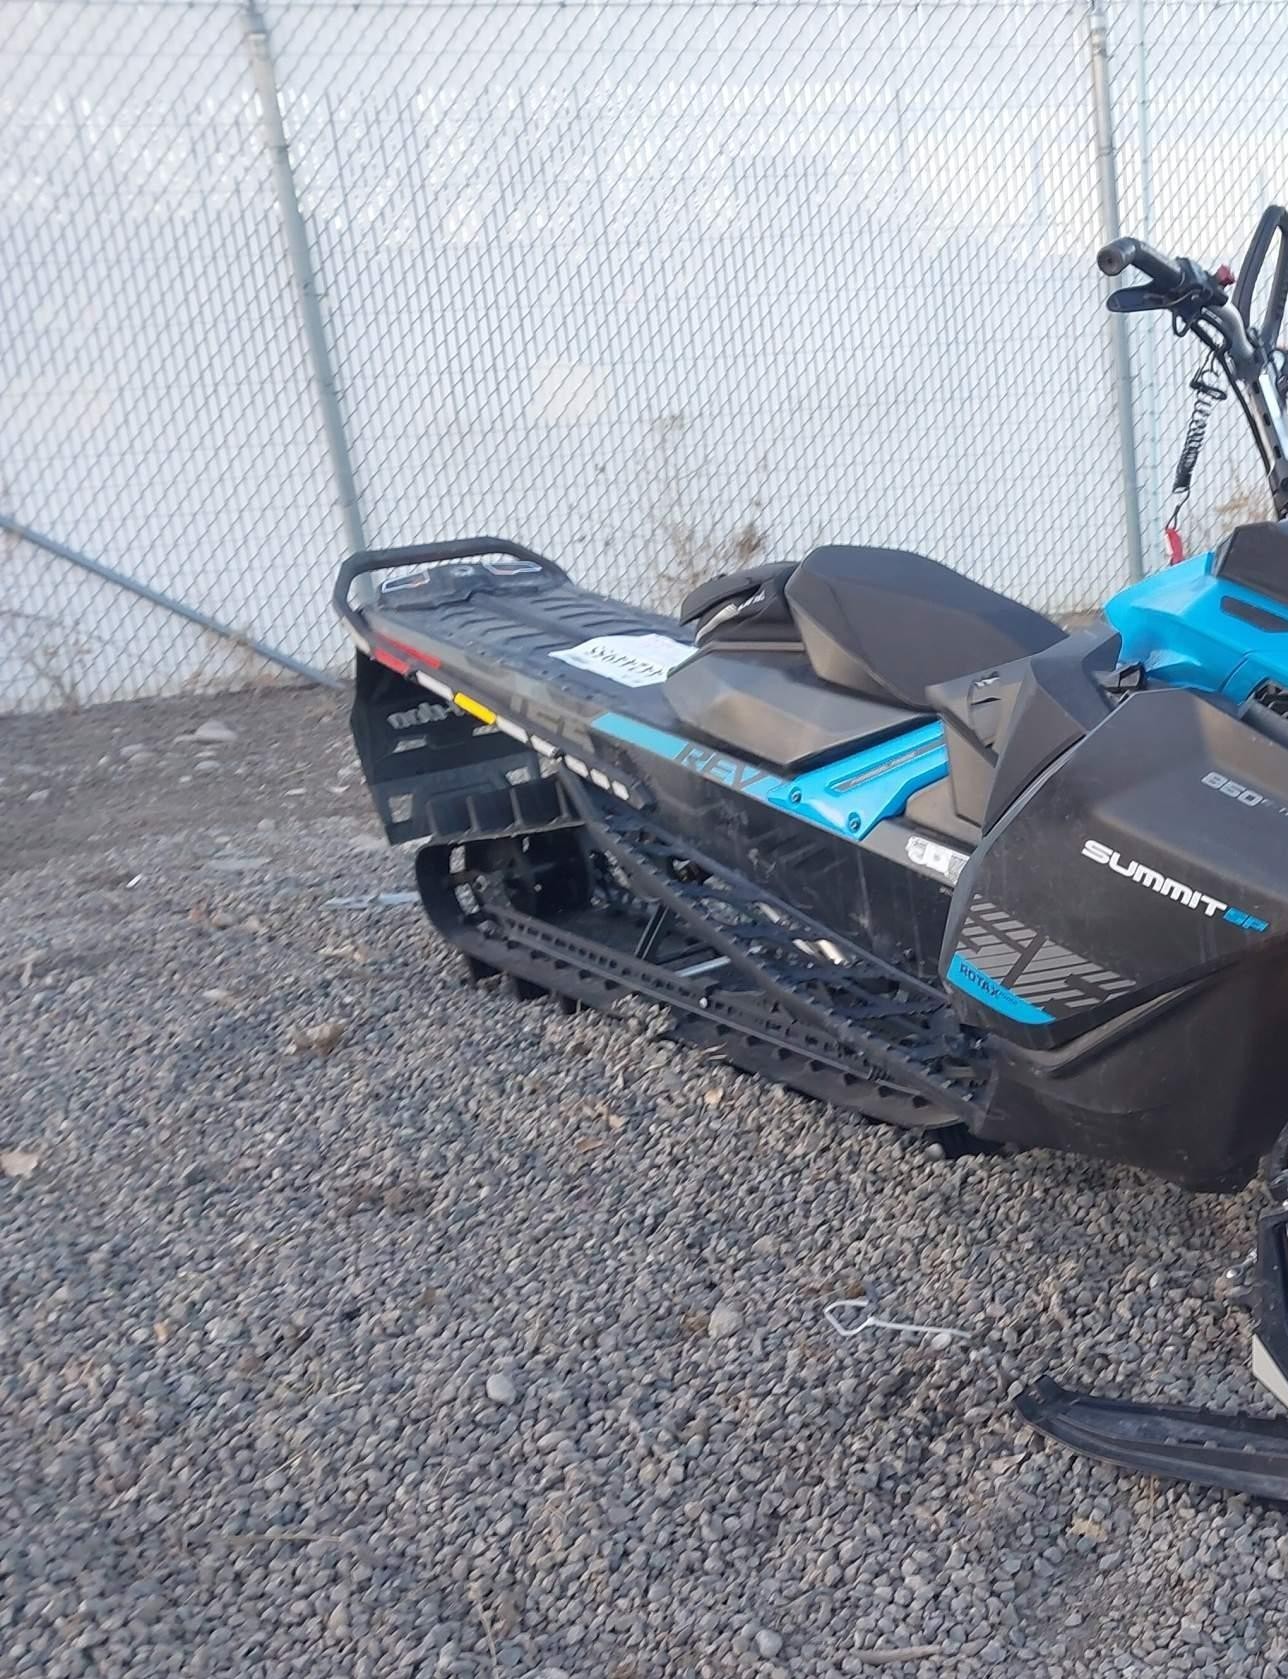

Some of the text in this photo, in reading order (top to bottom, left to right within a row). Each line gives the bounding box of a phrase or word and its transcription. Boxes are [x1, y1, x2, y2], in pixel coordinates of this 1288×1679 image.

[672, 743, 769, 793] REV
[1200, 771, 1263, 807] 850
[1081, 839, 1228, 917] SUMMIT
[960, 963, 1000, 997] ROTAX
